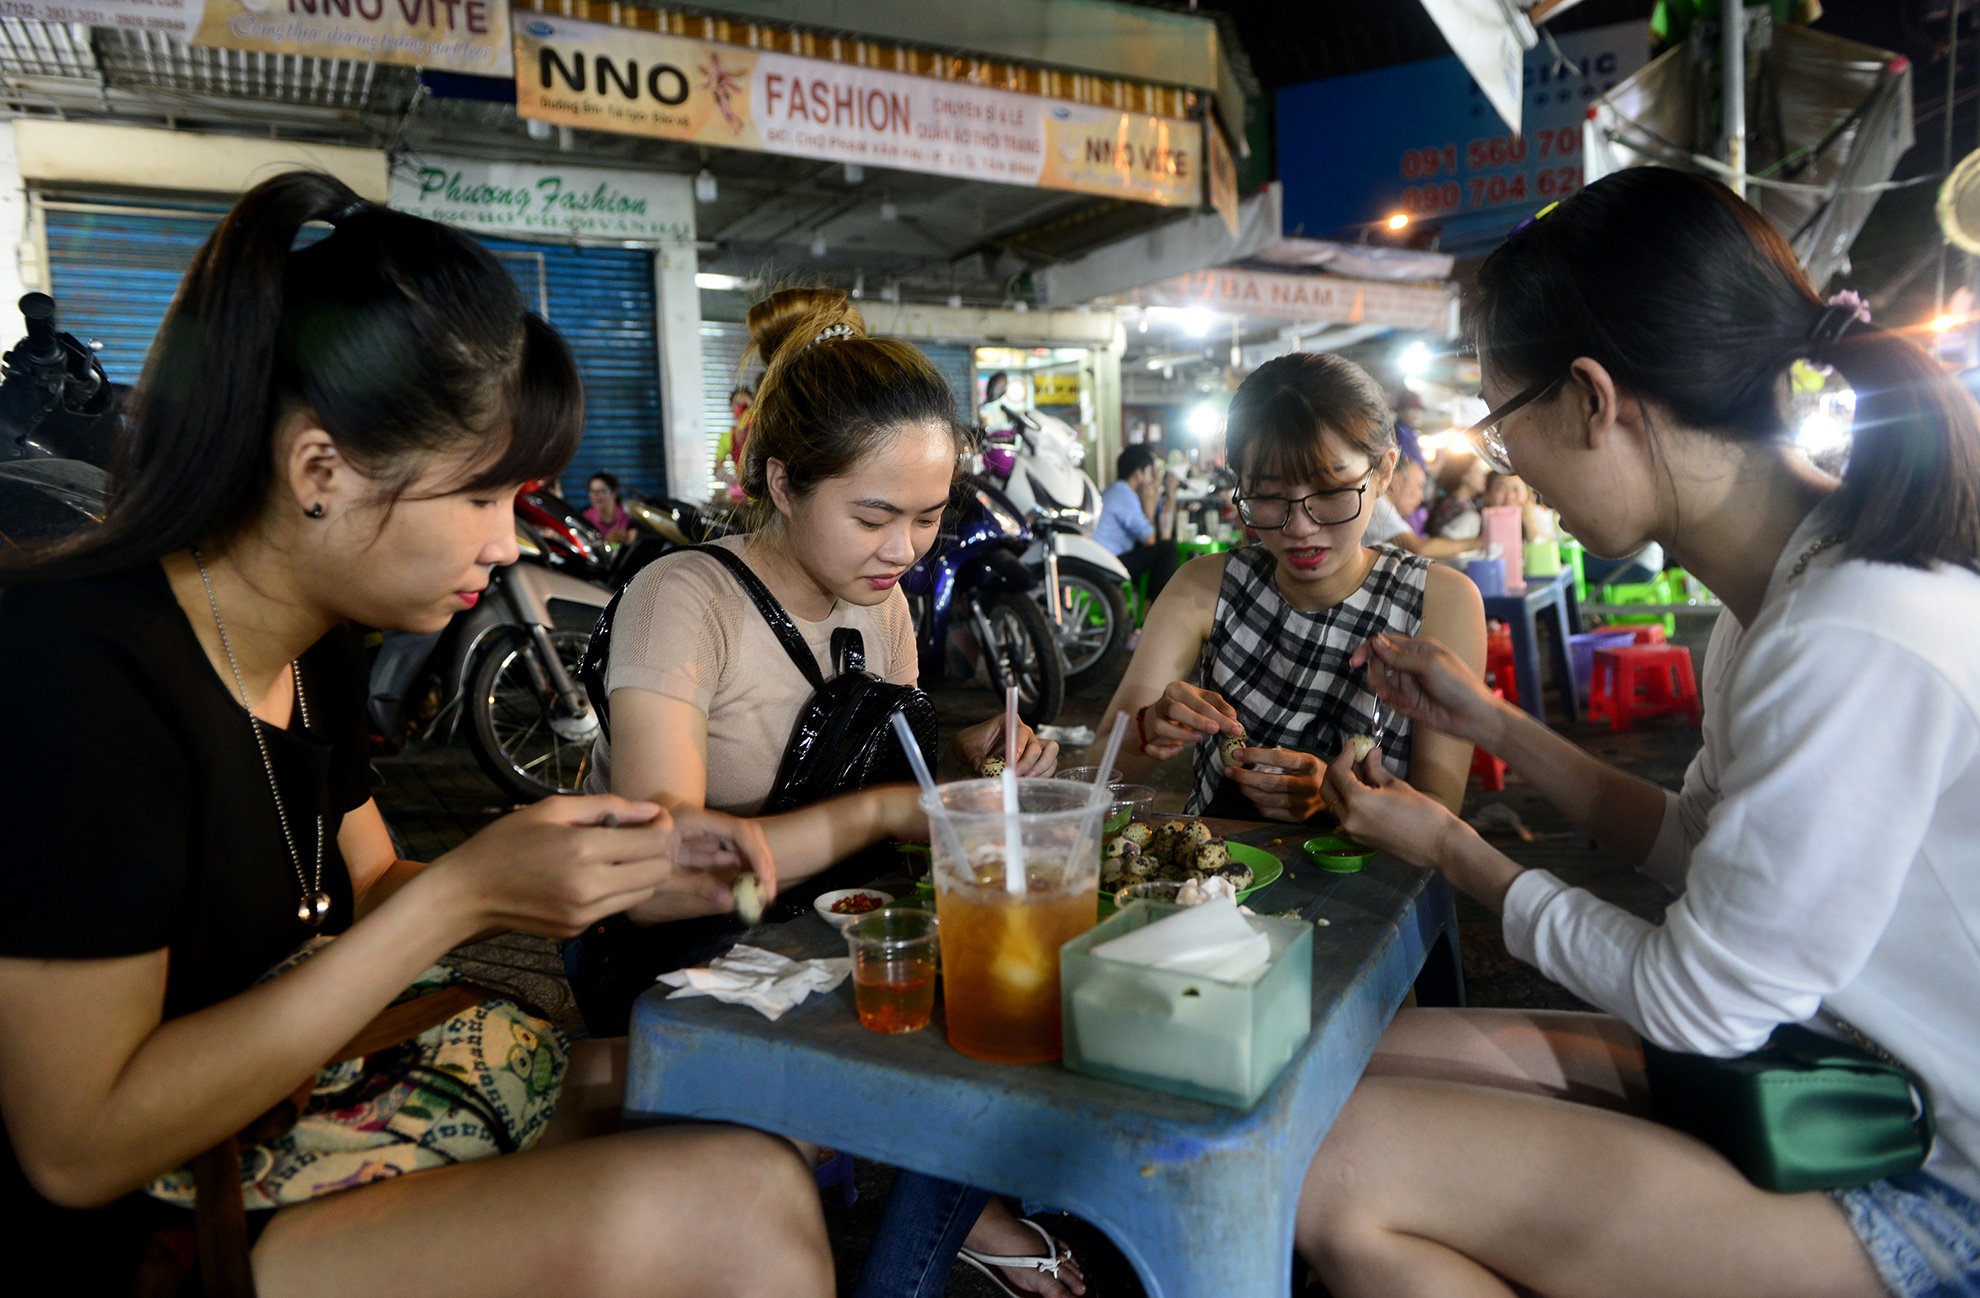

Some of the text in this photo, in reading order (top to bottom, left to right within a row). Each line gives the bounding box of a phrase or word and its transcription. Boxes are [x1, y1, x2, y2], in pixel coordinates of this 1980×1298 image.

[398, 0, 488, 33] VITE
[539, 46, 690, 105] NNO
[765, 72, 911, 135] FASHION
[1402, 126, 1583, 180] 091 560 70
[537, 176, 648, 215] Fashion
[1403, 166, 1584, 212] 090 704 62
